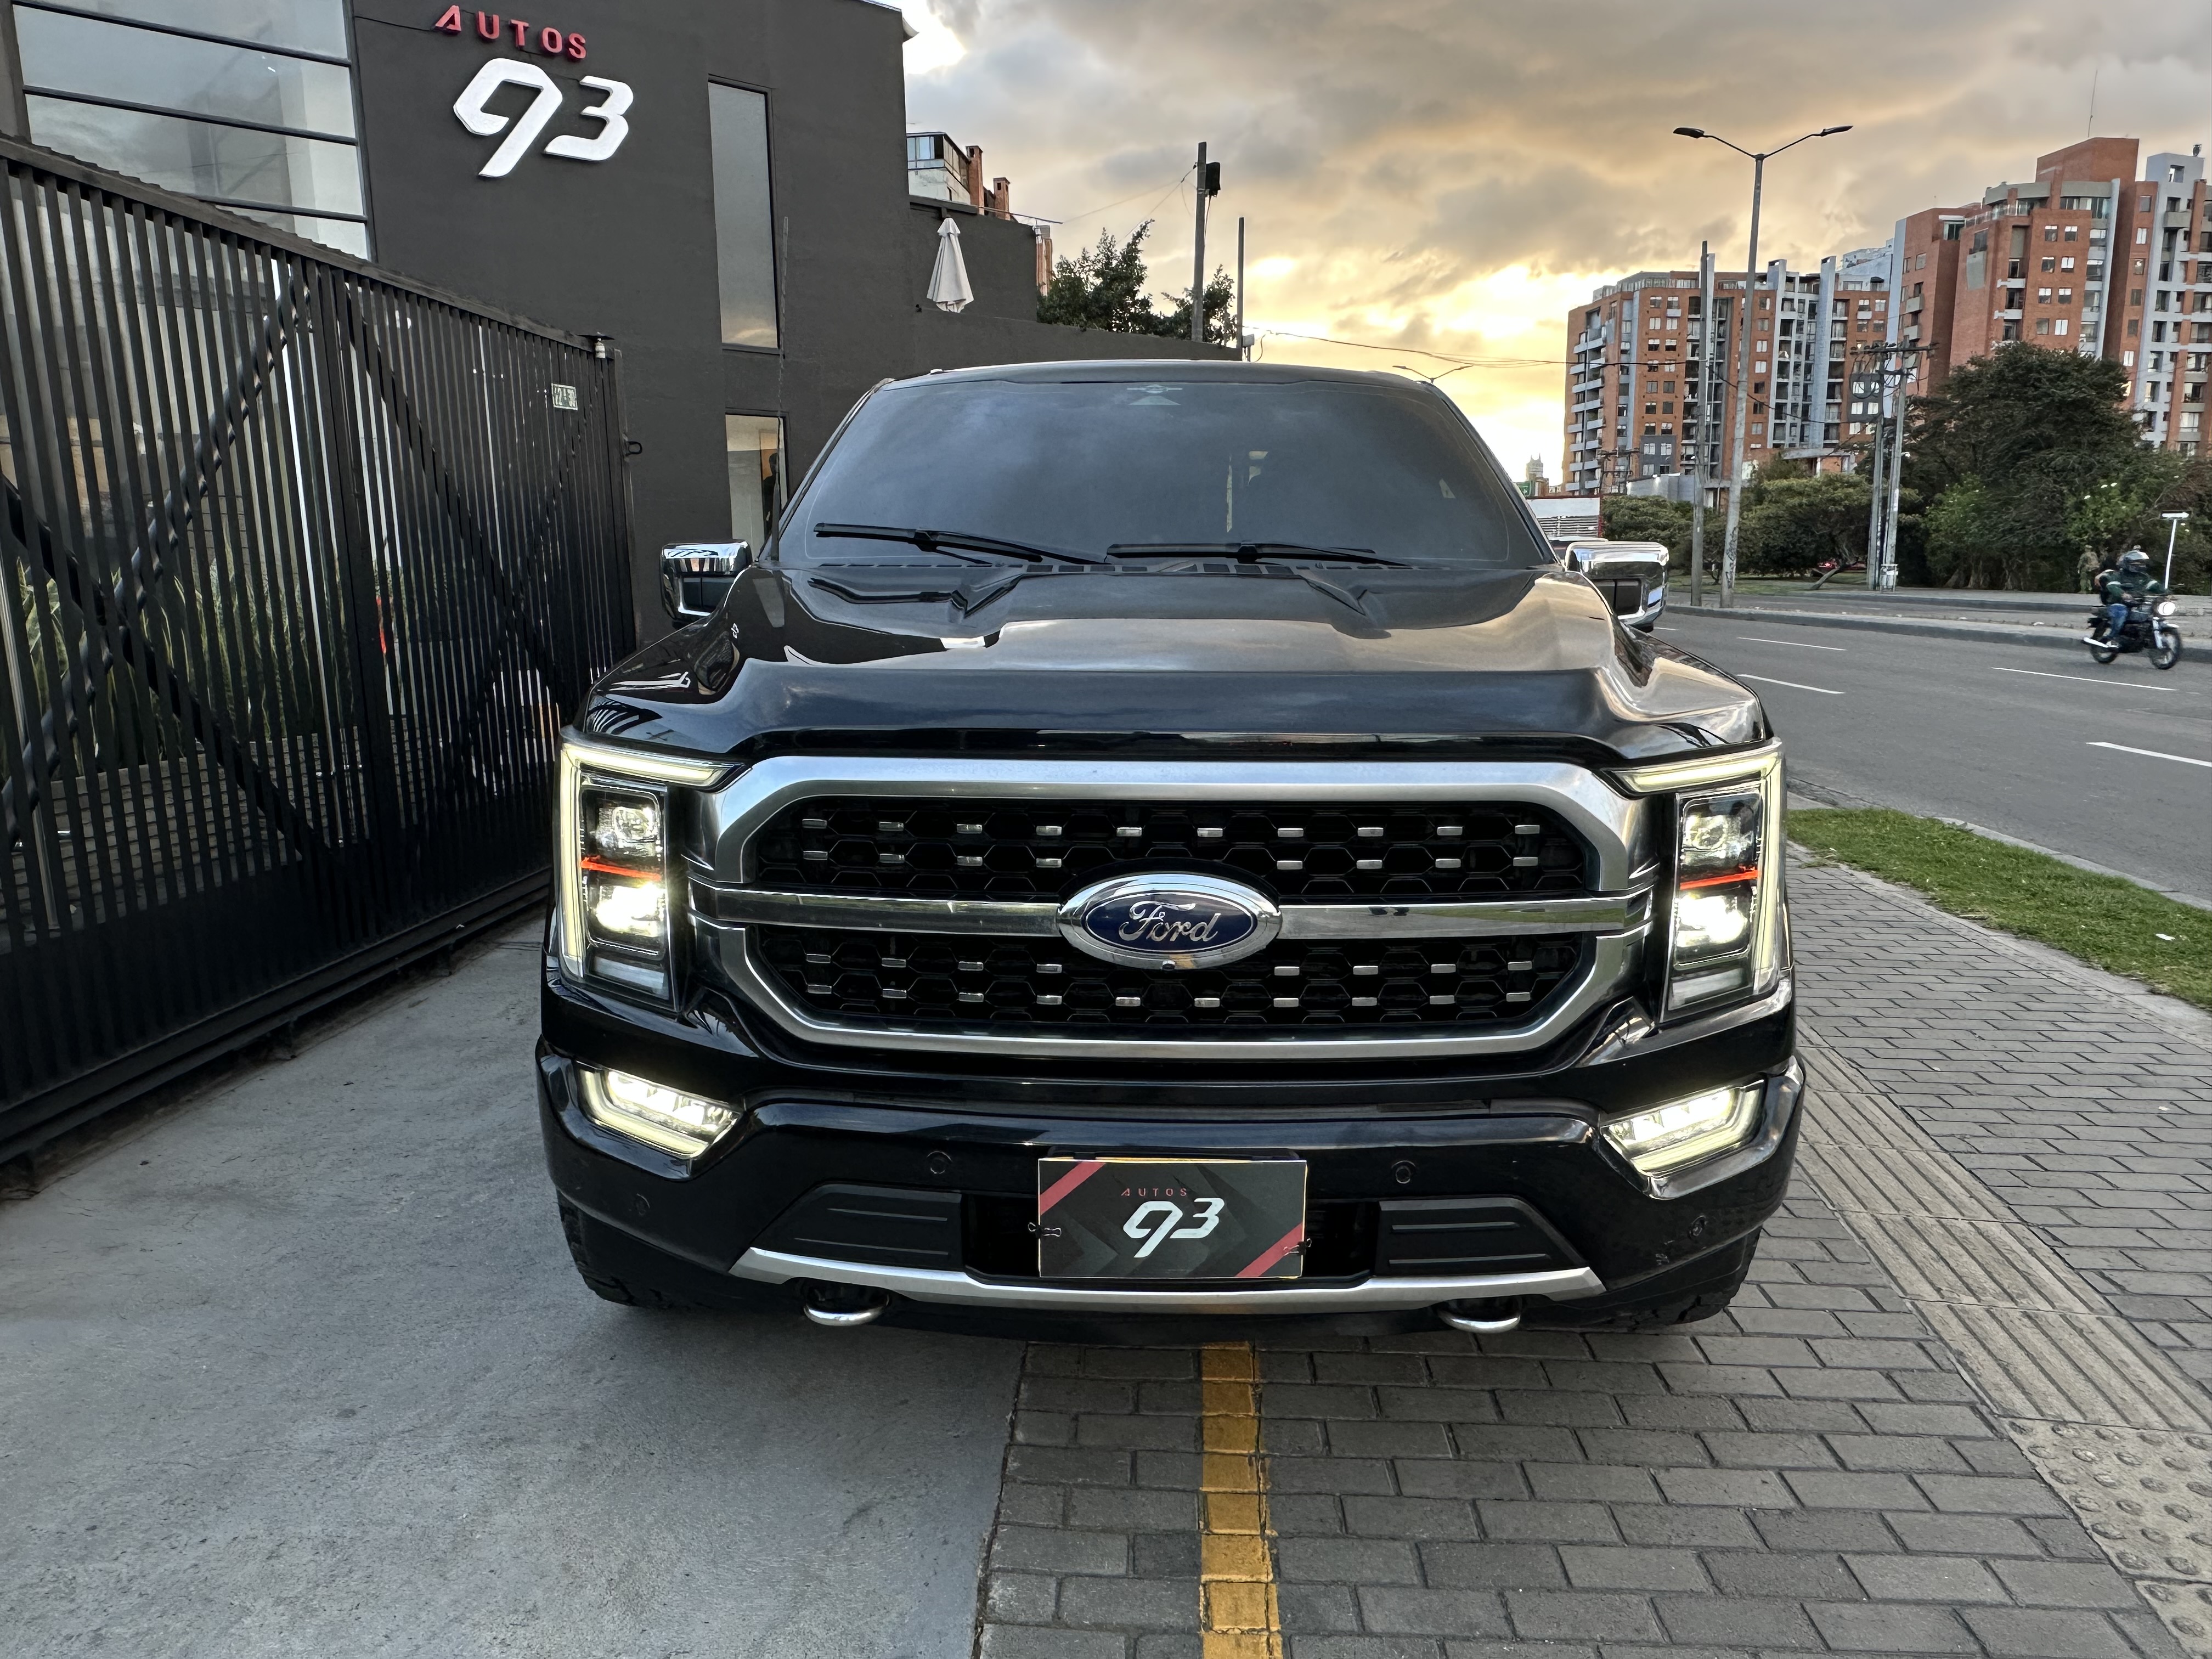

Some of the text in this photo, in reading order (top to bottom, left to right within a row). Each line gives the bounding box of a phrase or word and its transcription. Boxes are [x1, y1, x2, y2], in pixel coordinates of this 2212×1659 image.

[433, 4, 587, 60] AUTOS
[453, 58, 634, 178] 93
[1118, 900, 1221, 942] Ford
[1121, 1188, 1187, 1197] AUTOS
[1122, 1198, 1225, 1258] 93
